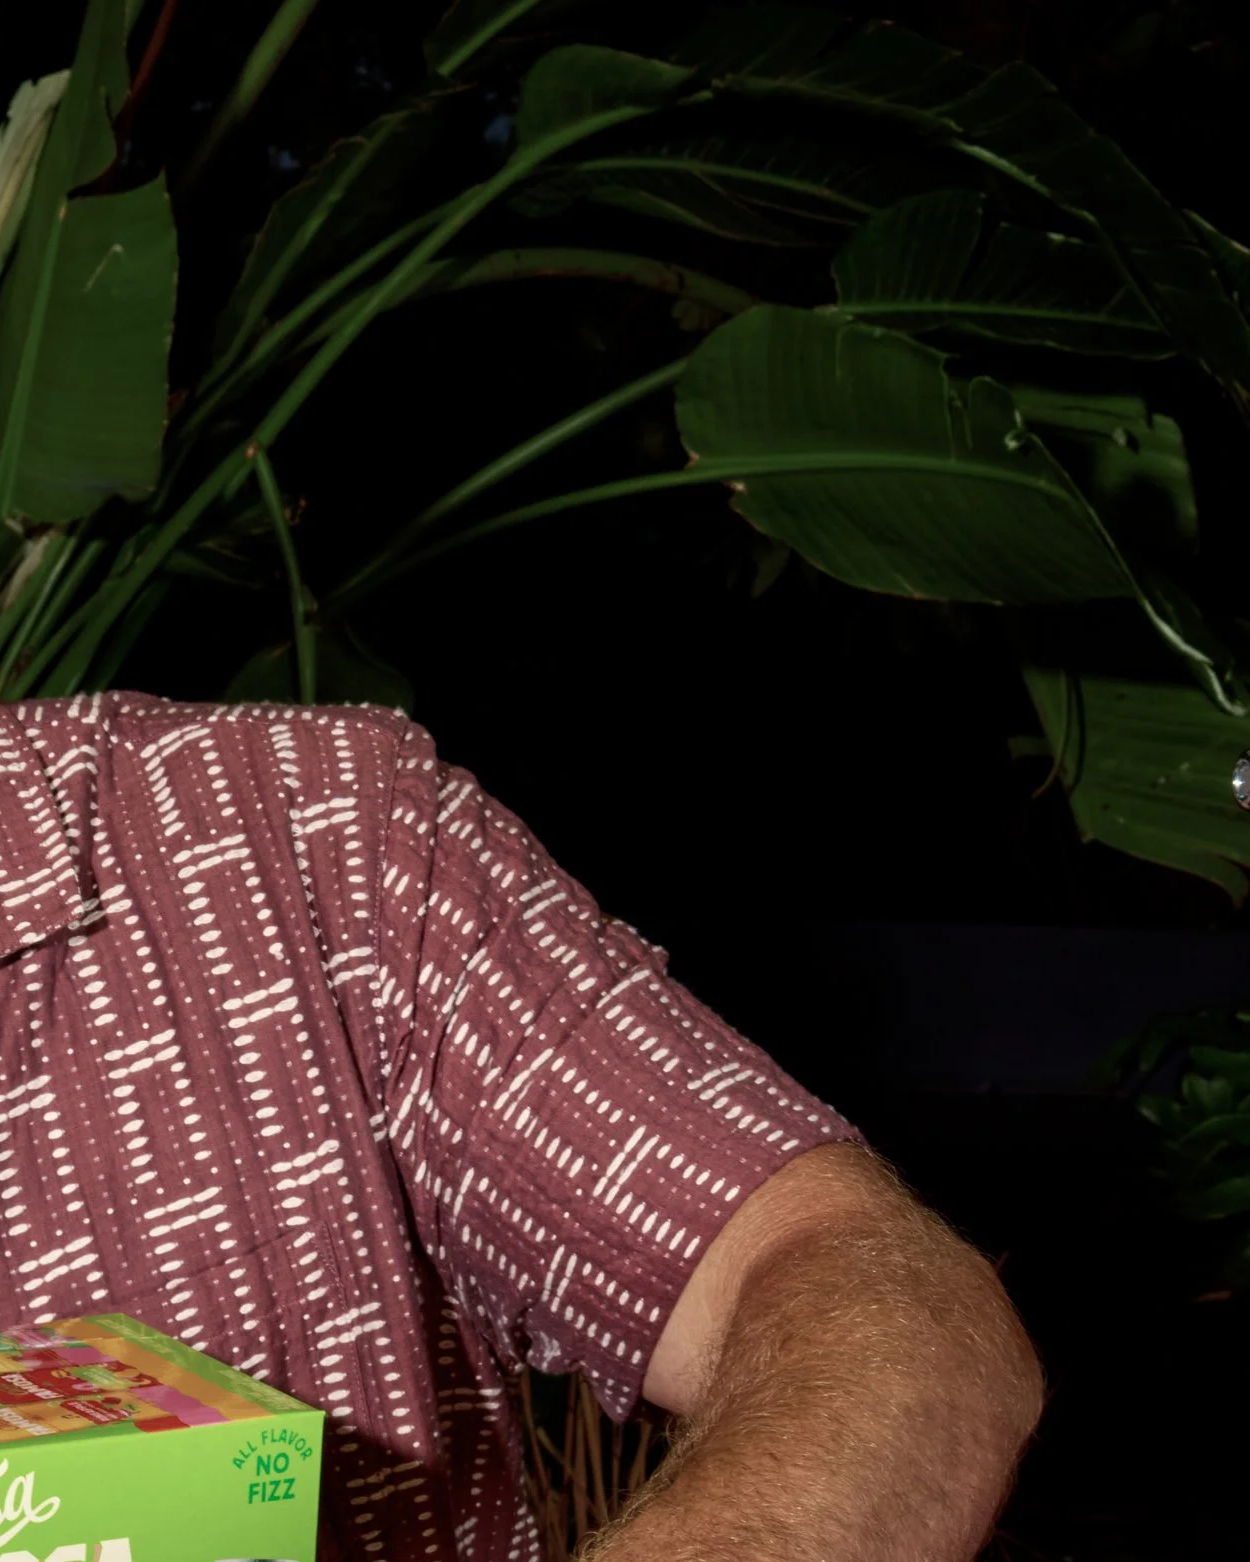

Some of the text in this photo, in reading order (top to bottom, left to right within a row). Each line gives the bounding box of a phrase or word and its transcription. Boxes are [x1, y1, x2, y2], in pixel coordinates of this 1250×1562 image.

[232, 1428, 313, 1469] ALL FLAVOR
[256, 1452, 290, 1476] NO
[248, 1477, 296, 1504] FIZZ
